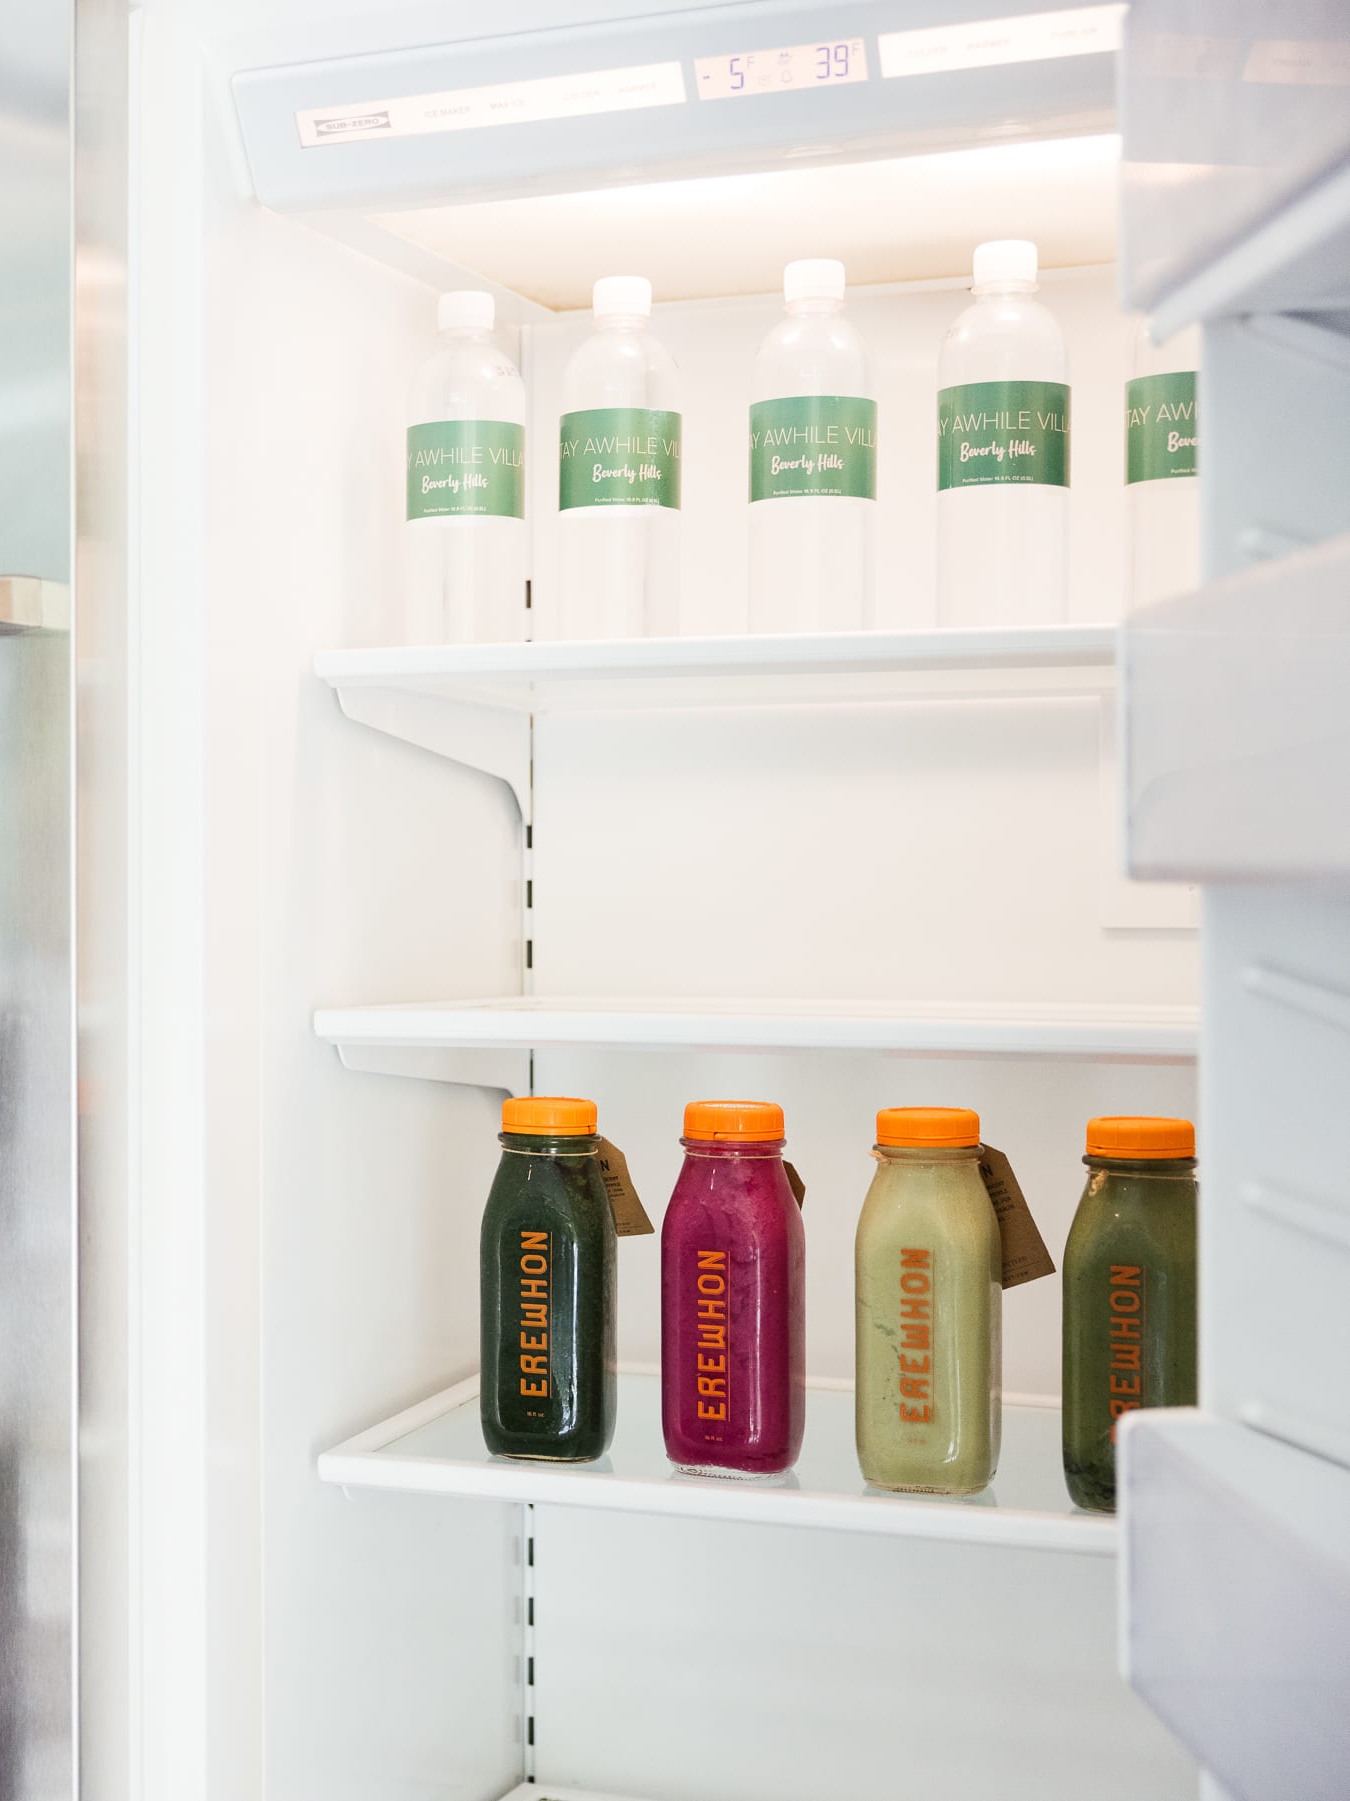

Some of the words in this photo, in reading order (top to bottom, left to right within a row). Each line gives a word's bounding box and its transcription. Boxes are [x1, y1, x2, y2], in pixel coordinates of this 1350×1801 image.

[816, 44, 849, 79] 39
[325, 117, 380, 132] SUB-ZERO
[952, 411, 1031, 434] AWHILE
[583, 437, 658, 455] AWHILE
[763, 425, 839, 448] AWHILE
[415, 446, 483, 468] AWHILE
[959, 441, 1006, 462] Beverly
[1007, 440, 1037, 459] Hills
[592, 464, 636, 484] Beverly
[638, 464, 663, 482] Hills
[770, 454, 816, 475] Beverly
[817, 454, 845, 472] Hills
[422, 474, 461, 494] Beverly
[462, 473, 490, 490] Hills
[520, 1231, 548, 1397] EREWHON
[697, 1250, 727, 1420] EREWHON
[899, 1248, 930, 1424] EREWHON
